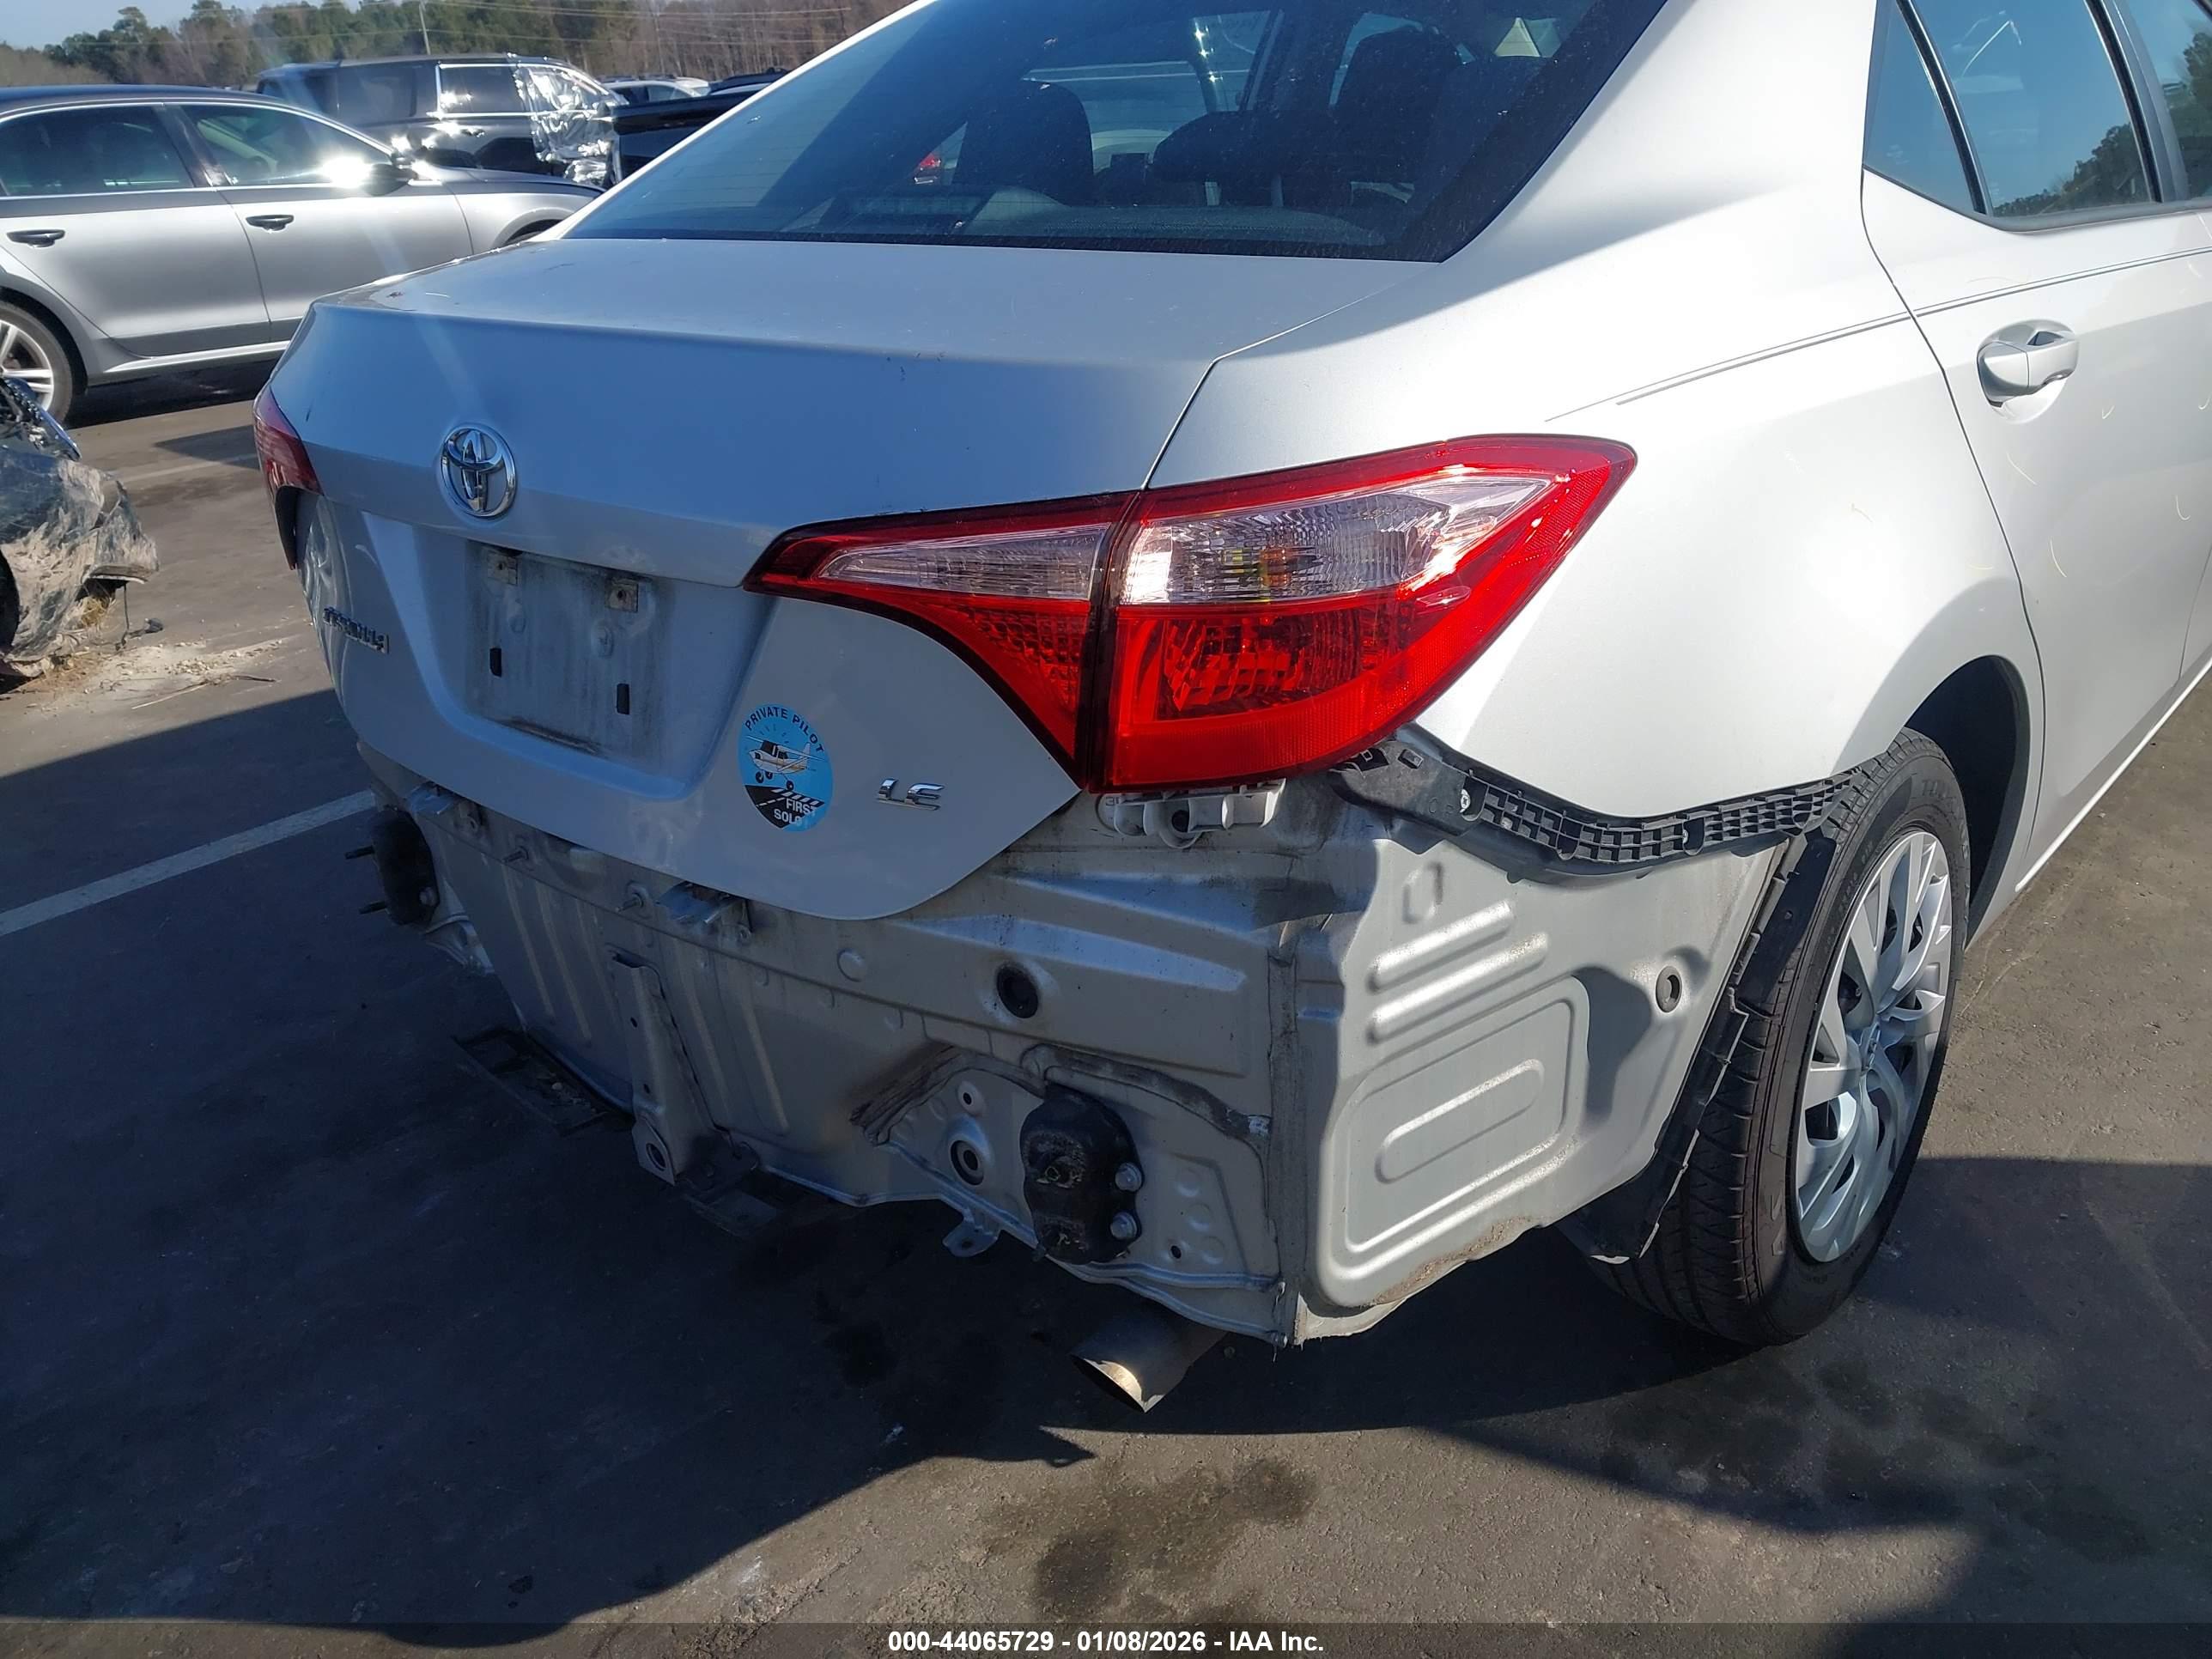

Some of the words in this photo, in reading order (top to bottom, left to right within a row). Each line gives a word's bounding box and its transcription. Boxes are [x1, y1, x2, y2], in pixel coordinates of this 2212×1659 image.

[323, 606, 390, 654] OLLA
[744, 706, 788, 731] PRIVATE
[792, 714, 824, 752] PILOT
[786, 798, 817, 816] FIRST
[876, 777, 945, 811] LE
